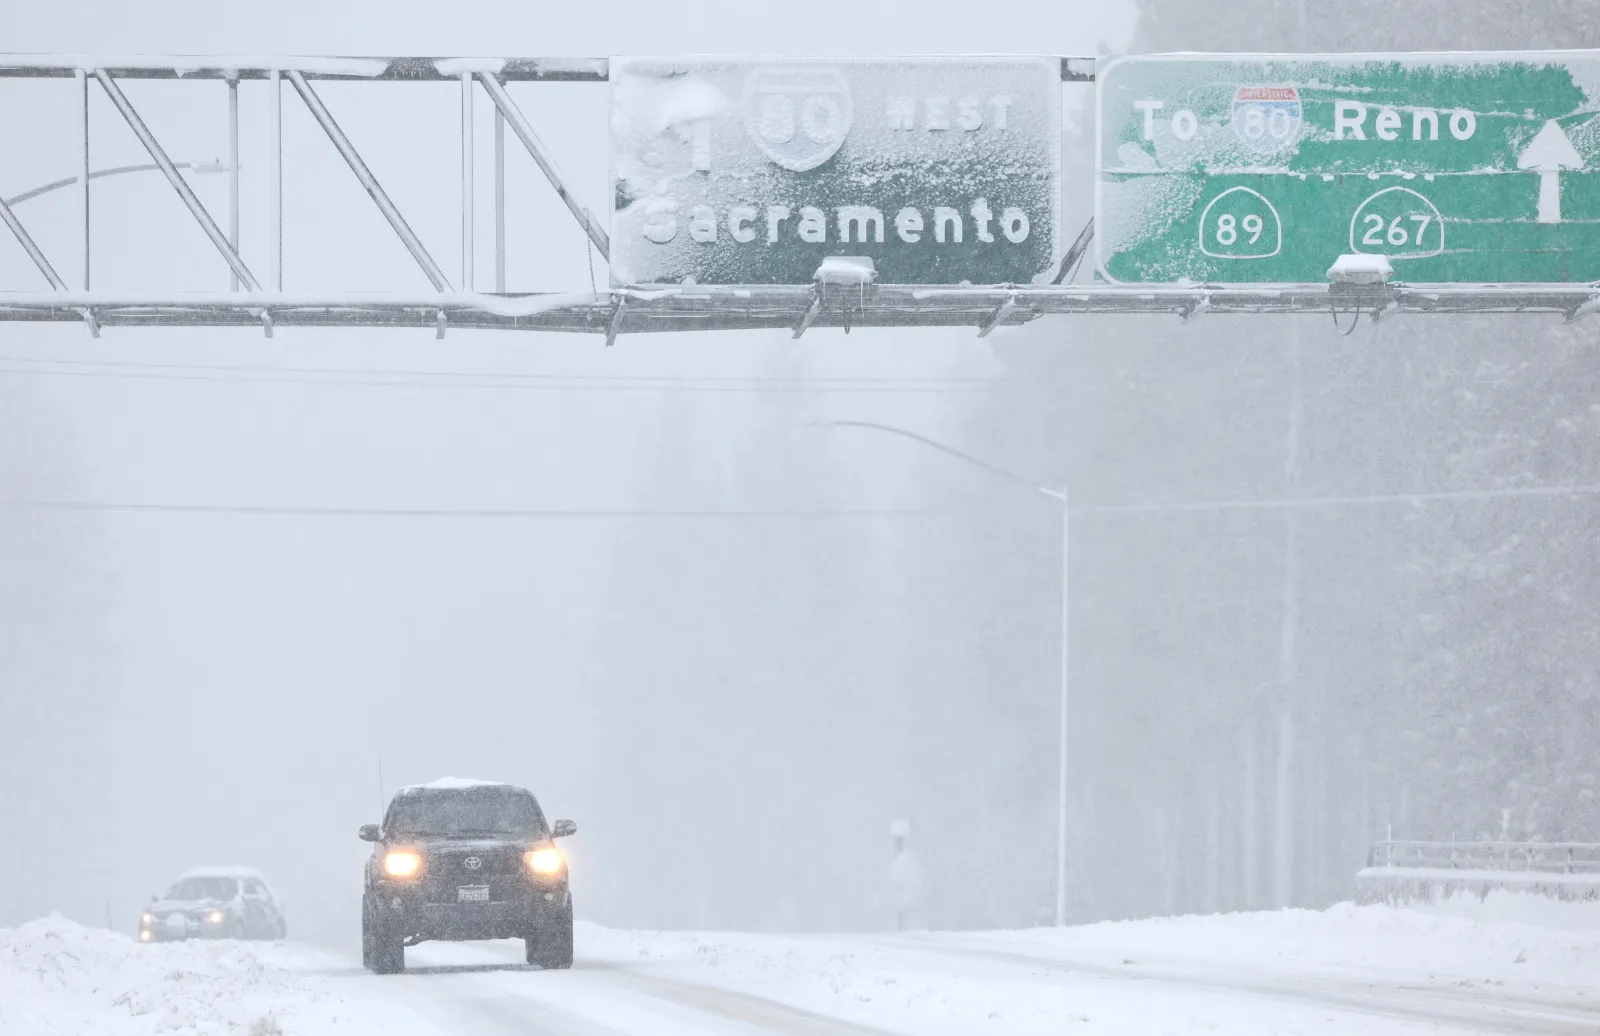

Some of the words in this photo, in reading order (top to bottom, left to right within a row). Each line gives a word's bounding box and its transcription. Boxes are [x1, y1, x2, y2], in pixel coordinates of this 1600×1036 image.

[757, 94, 839, 144] 80
[886, 96, 1012, 132] WEST
[1133, 100, 1198, 140] To
[1243, 108, 1291, 139] 80
[1334, 100, 1477, 141] Reno
[642, 197, 1031, 244] Sacramento
[1216, 214, 1264, 246] 89
[1361, 214, 1432, 246] 267
